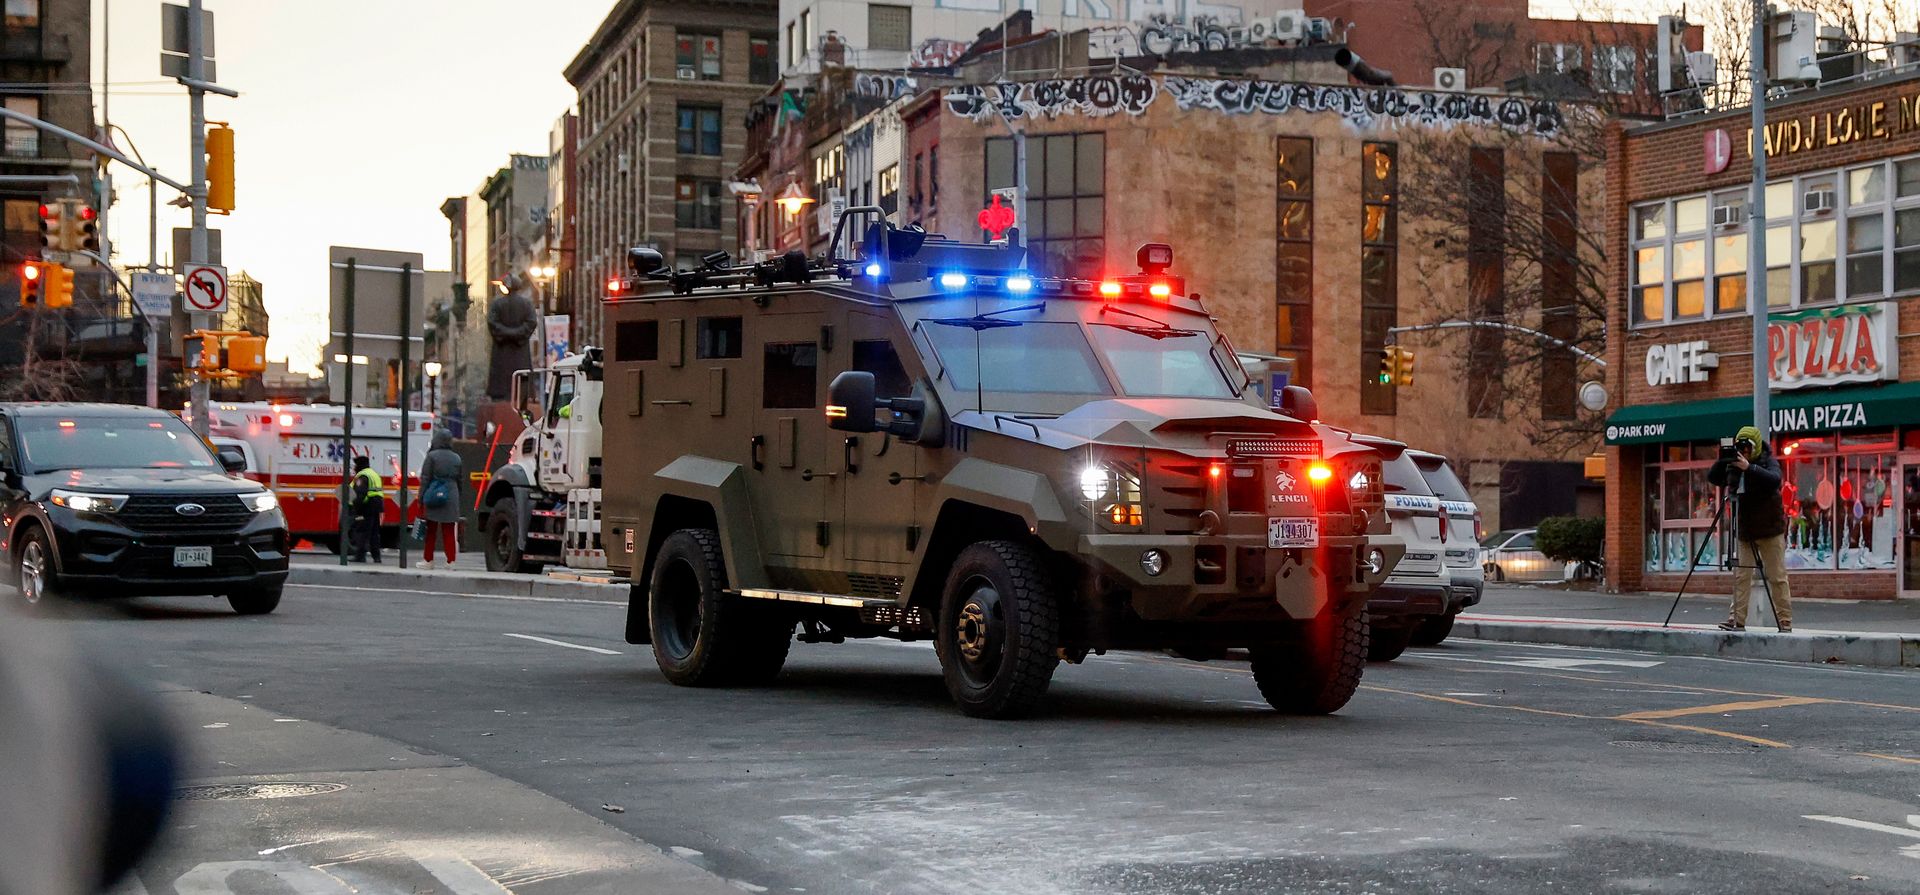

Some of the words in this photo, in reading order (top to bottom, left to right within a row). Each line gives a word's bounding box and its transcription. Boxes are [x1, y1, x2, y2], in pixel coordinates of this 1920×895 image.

[1768, 314, 1878, 381] PIZZA
[1646, 341, 1709, 387] CAFE
[1769, 407, 1809, 433] UNA
[1814, 403, 1867, 429] PIZZA
[1619, 426, 1642, 438] PARK
[1644, 424, 1666, 436] ROW
[312, 465, 348, 474] AMBULA
[1395, 496, 1433, 508] POLICE
[1275, 524, 1312, 539] J134307
